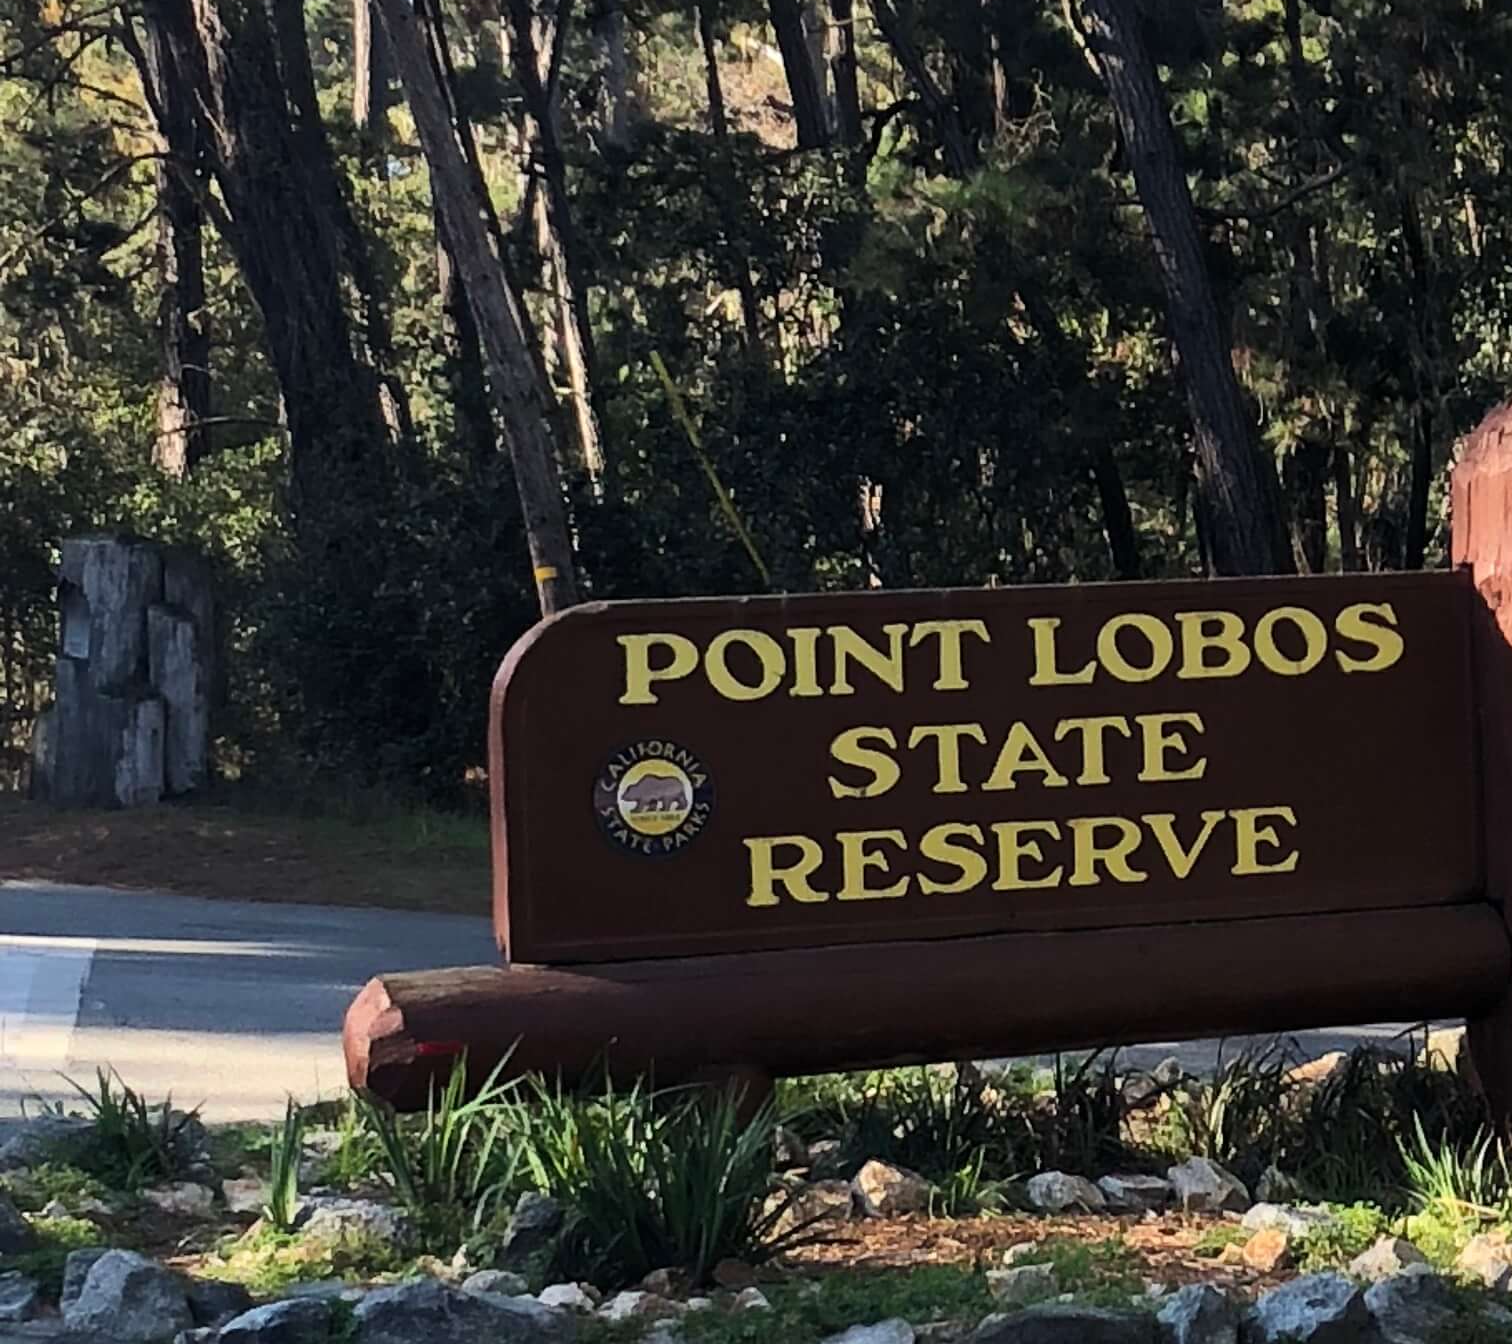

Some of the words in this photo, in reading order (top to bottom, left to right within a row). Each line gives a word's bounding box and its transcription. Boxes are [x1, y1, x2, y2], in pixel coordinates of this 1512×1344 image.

[616, 618, 992, 705] POINT
[1026, 602, 1405, 687] LOBOS
[600, 739, 707, 792] CALIFORNIA
[827, 711, 1208, 800] STATE
[600, 807, 654, 855] STATE
[662, 802, 711, 852] PARKS
[742, 806, 1300, 908] RESERVE
